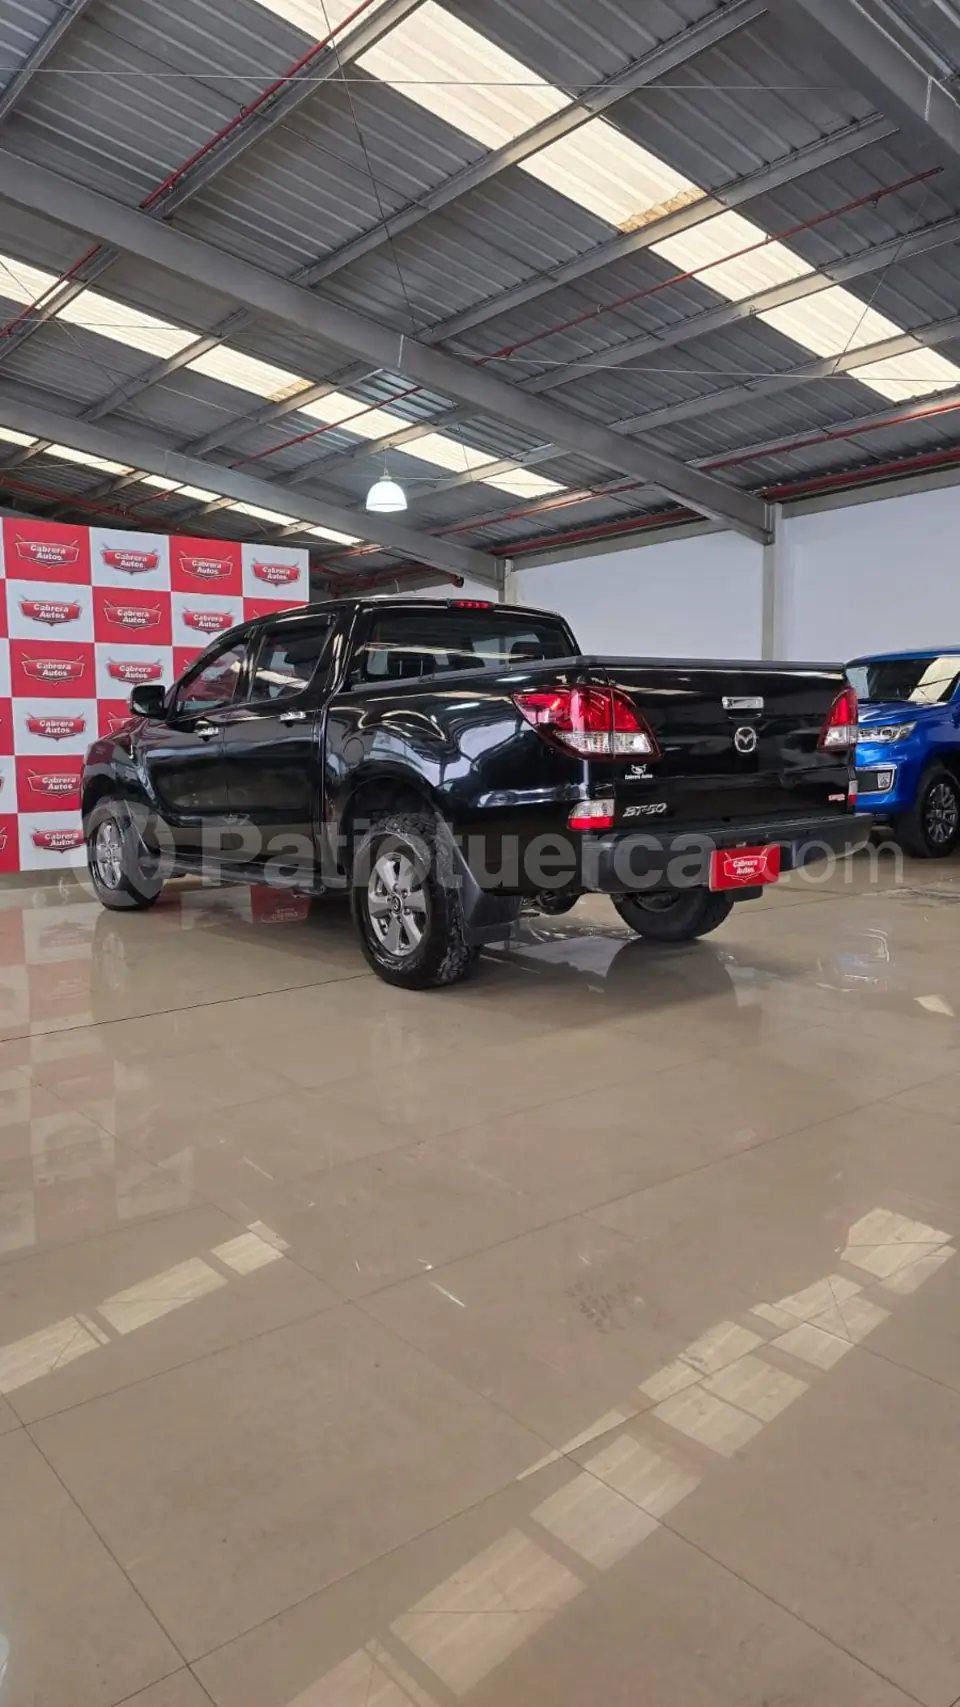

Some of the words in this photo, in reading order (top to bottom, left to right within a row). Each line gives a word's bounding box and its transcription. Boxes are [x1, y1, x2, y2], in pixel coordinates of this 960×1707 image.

[30, 544, 66, 554] Cabrera
[36, 552, 62, 561] Autos
[114, 553, 147, 562] Cabrera
[120, 560, 144, 568] Autos
[192, 559, 222, 569] Cabrera
[197, 567, 219, 575] Autos
[262, 567, 290, 575] Cabrera
[33, 603, 69, 613] Cabrera
[39, 611, 65, 619] Autos
[117, 609, 149, 618] Cabrera
[122, 616, 146, 624] Autos
[193, 614, 223, 623] Cabrera
[36, 662, 72, 671] Cabrera
[119, 665, 152, 673] Cabrera
[42, 669, 68, 677] Autos
[124, 671, 148, 679] Autos
[39, 719, 74, 728] Cabrera
[45, 726, 70, 734] Autos
[42, 776, 76, 784] Cabrera
[47, 782, 73, 790] Autos
[622, 802, 667, 817] BT-50
[44, 832, 79, 840] Cabrera
[50, 839, 76, 847] Autos
